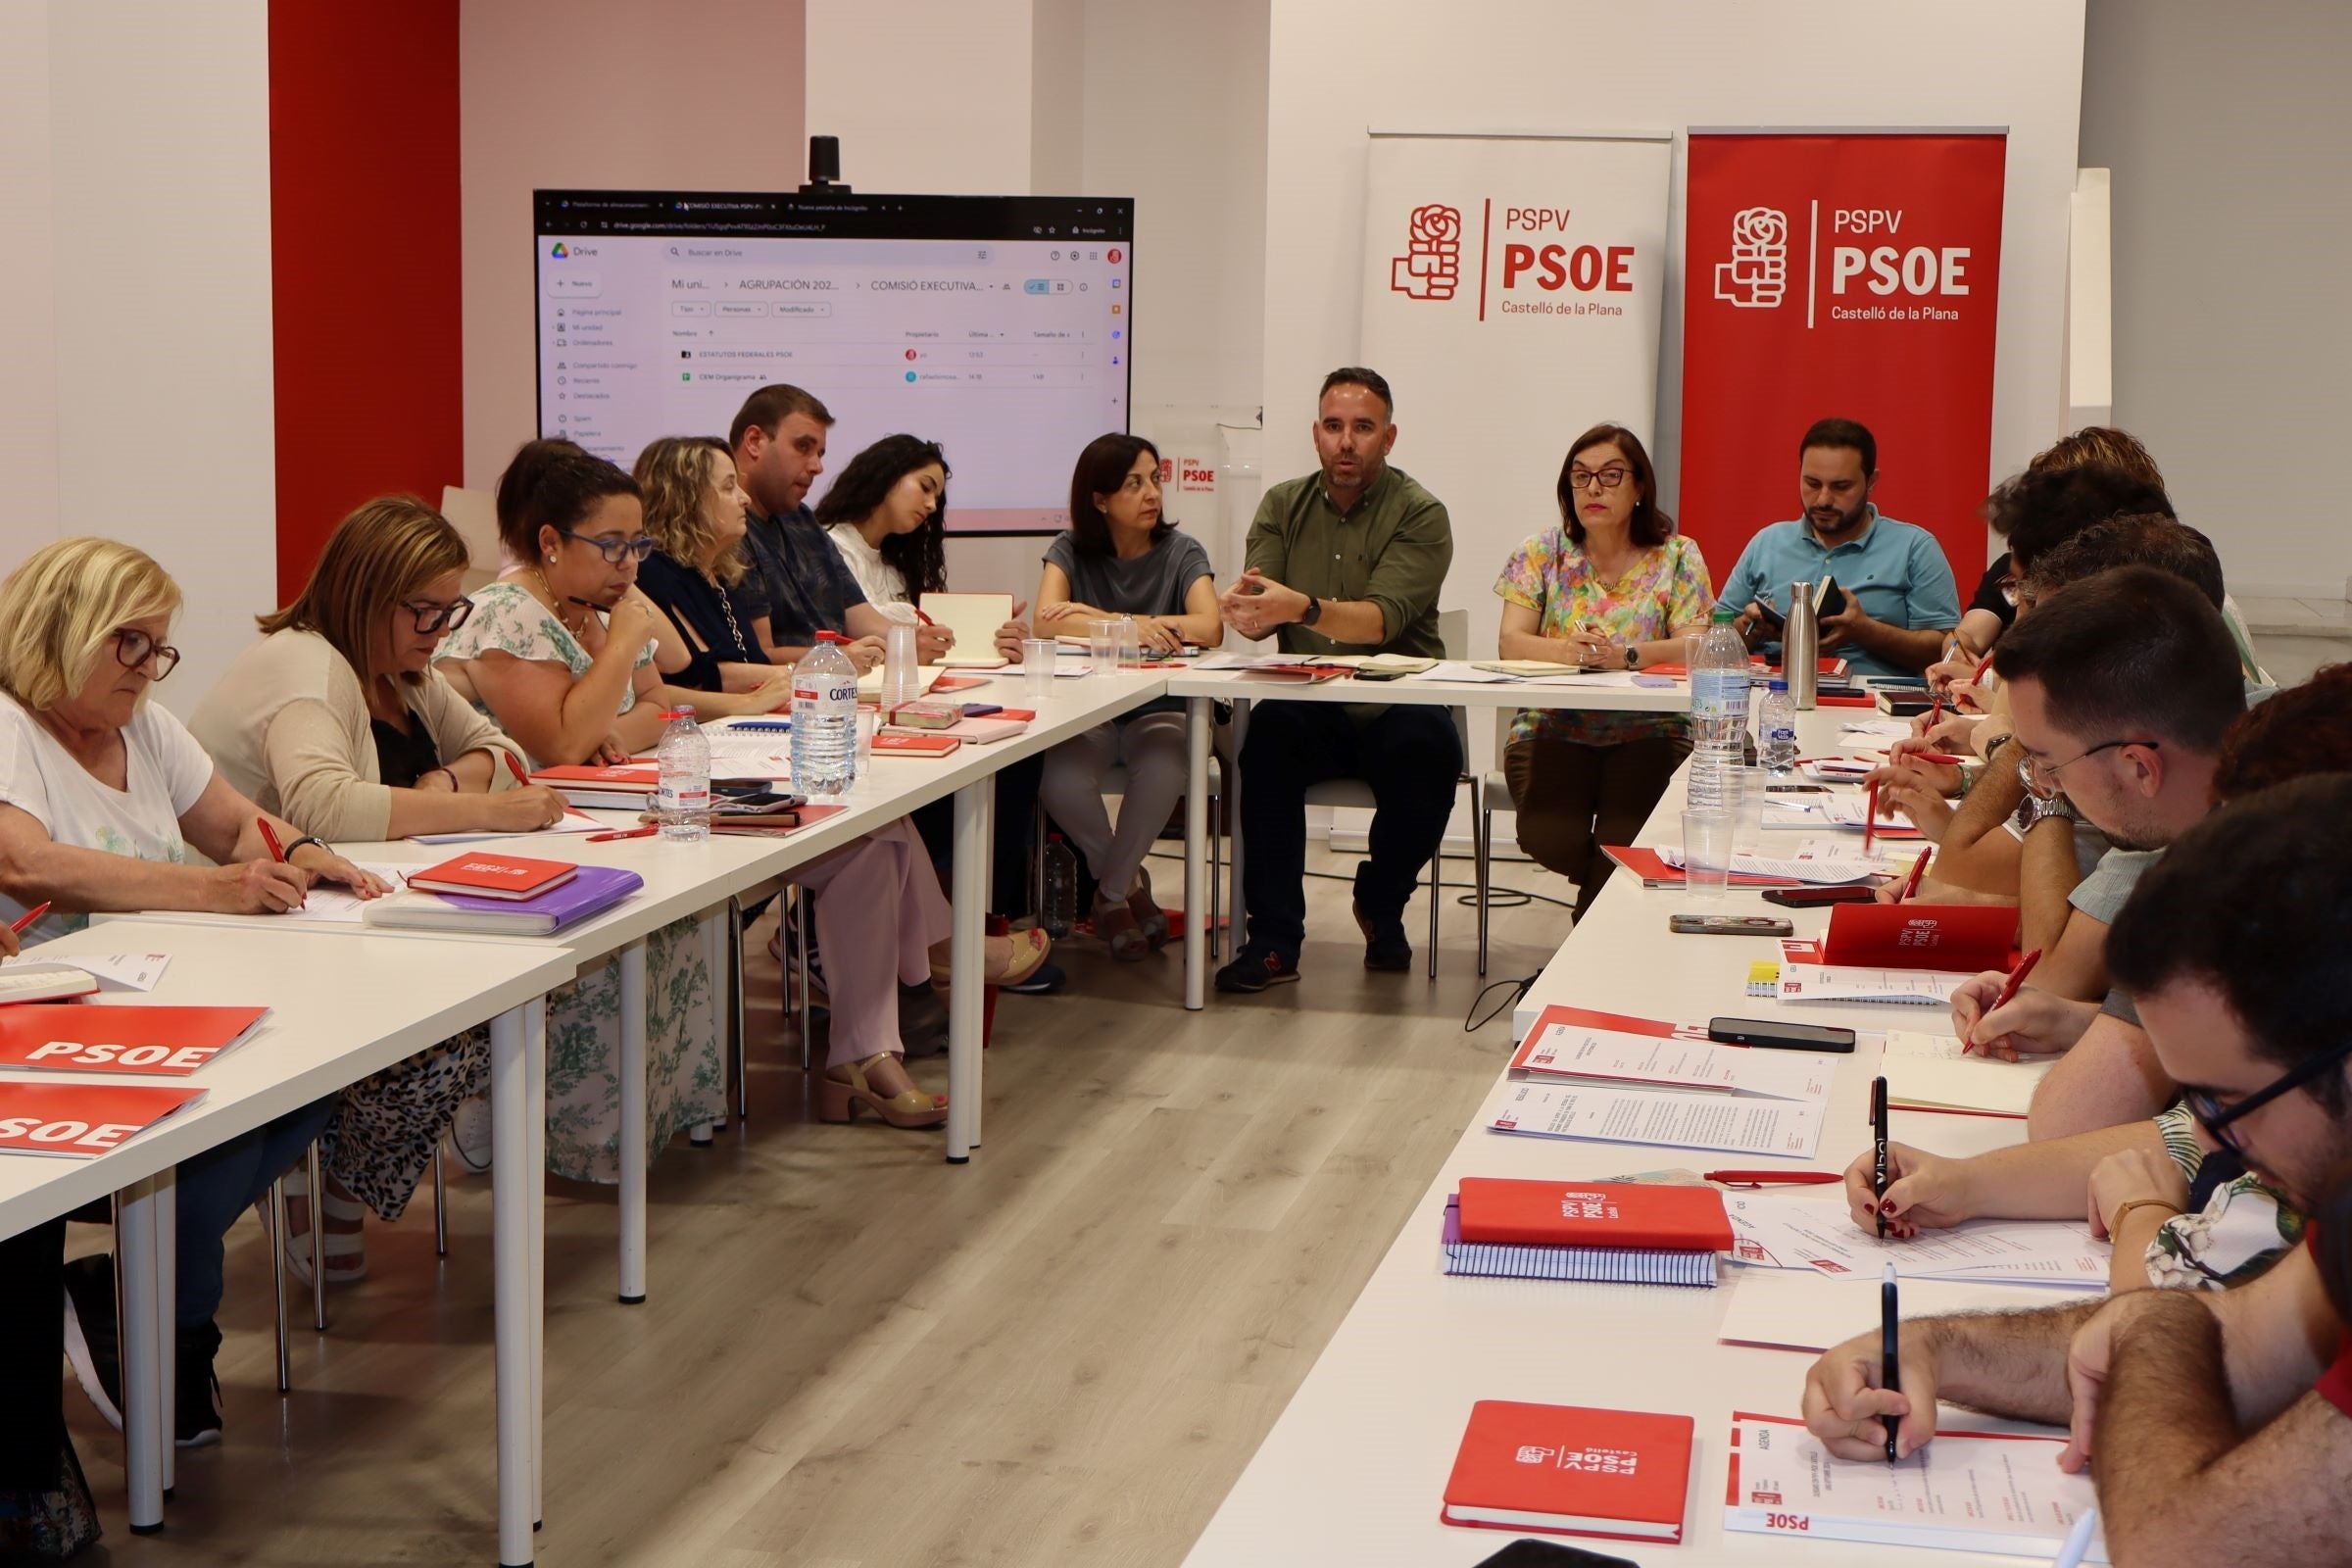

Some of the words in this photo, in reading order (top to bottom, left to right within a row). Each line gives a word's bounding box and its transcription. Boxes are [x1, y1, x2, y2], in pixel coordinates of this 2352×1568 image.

[1505, 208, 1570, 231] PSPV
[1834, 209, 1902, 233] PSPV
[573, 247, 598, 256] Drive
[688, 248, 713, 257] Buscar
[1503, 243, 1635, 292] PSOE
[1832, 246, 1971, 296] PSOE
[671, 279, 684, 289] Mi
[739, 278, 810, 290] AGRUPACIÓN
[870, 279, 918, 291] COMISIÓ
[1501, 300, 1553, 315] Castelló
[1556, 302, 1572, 316] de
[1575, 302, 1586, 316] la
[1589, 302, 1623, 317] Plana
[1832, 306, 1886, 319] Castelló
[1888, 306, 1905, 320] de
[1908, 306, 1920, 320] la
[1922, 307, 1959, 320] Plana
[1183, 469, 1214, 482] PSOE
[1913, 930, 1931, 947] PSOE
[24, 1041, 220, 1068] PSOE
[0, 1117, 147, 1148] SOE
[1561, 1201, 1579, 1218] PSPV
[1582, 1201, 1604, 1219] PSOE
[1758, 1429, 1771, 1450] AGENDA
[1566, 1451, 1639, 1467] PSOE
[1585, 1446, 1639, 1456] Castelló
[1564, 1460, 1636, 1475] PSPV
[1765, 1512, 1810, 1531] PSOE
